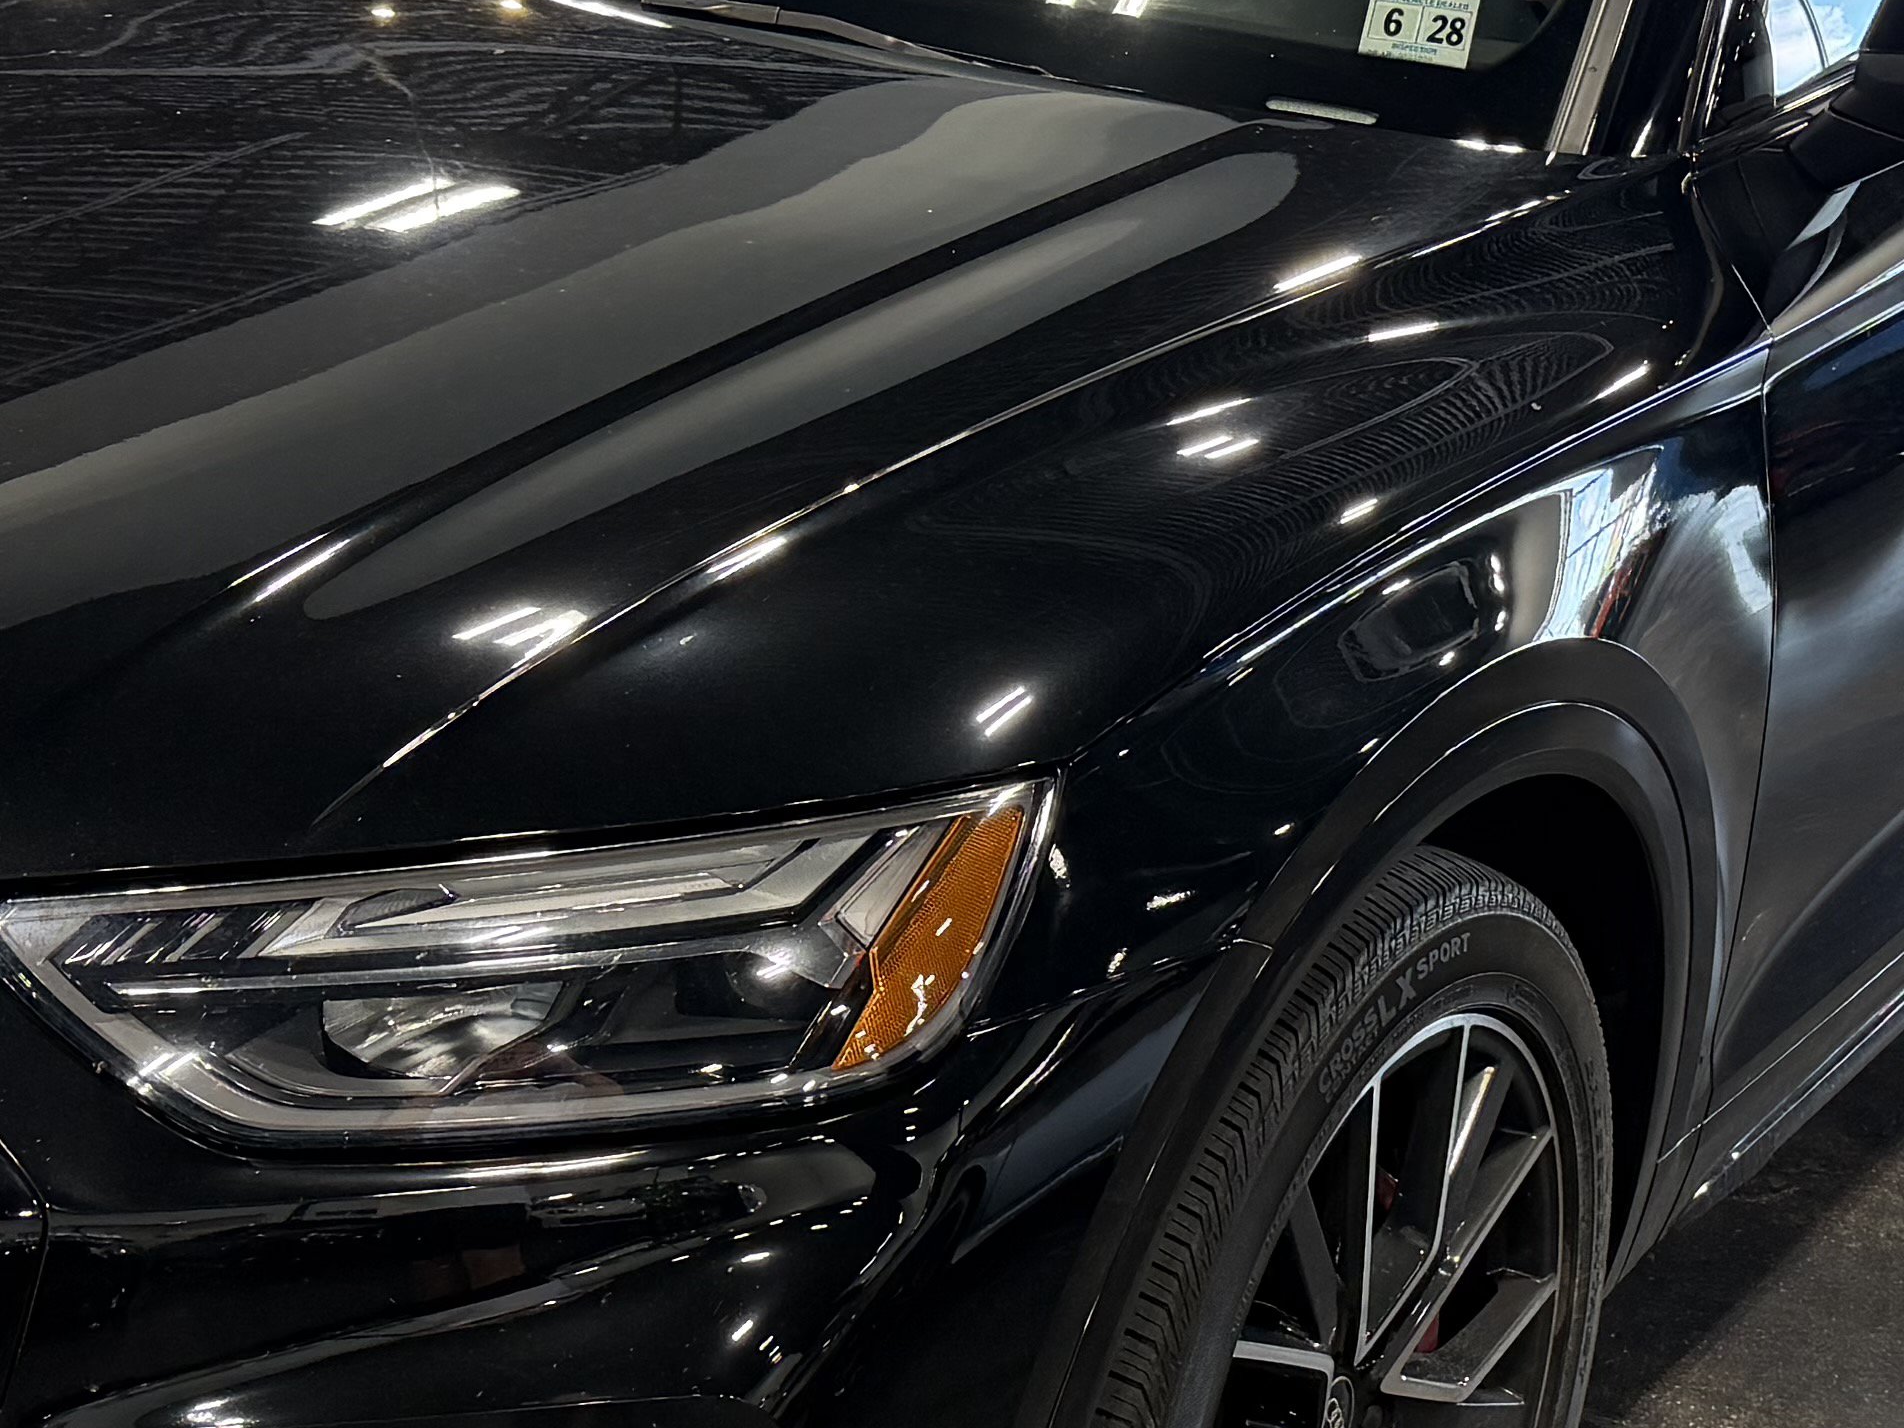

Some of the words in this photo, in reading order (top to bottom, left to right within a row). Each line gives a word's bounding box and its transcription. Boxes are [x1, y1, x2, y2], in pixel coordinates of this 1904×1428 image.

[1383, 7, 1404, 37] 6
[1426, 15, 1466, 46] 28
[1318, 1006, 1377, 1095] CROSS
[1377, 967, 1417, 1028] LX
[1416, 932, 1471, 981] SPORT
